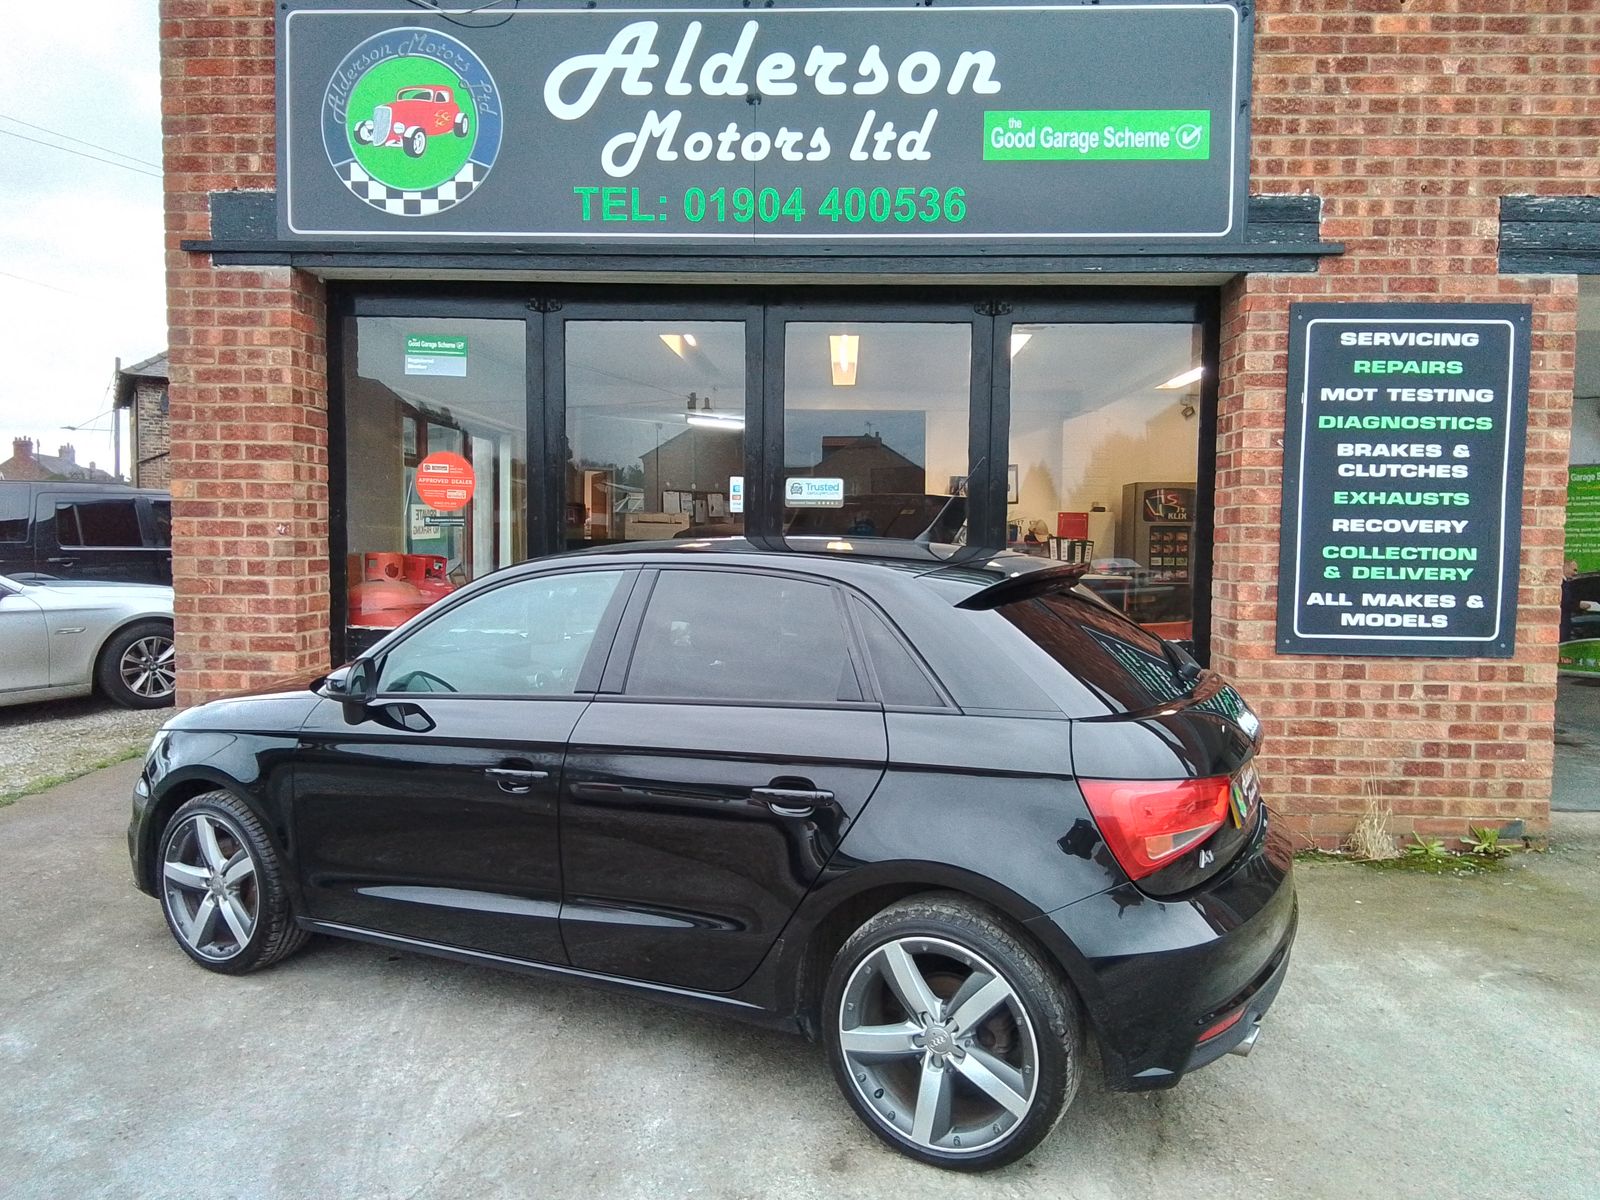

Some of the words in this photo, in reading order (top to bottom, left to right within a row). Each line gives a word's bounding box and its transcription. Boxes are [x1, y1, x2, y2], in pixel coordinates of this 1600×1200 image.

[543, 19, 1002, 120] Alderson
[327, 45, 393, 125] Alderson
[397, 33, 471, 72] Motors
[1008, 117, 1022, 129] the
[601, 109, 832, 178] Motors
[849, 108, 939, 162] ltd
[990, 127, 1036, 149] Good
[1040, 127, 1099, 153] Garage
[1103, 126, 1170, 148] Scheme
[573, 187, 667, 221] TEL:
[683, 187, 806, 222] 01904
[818, 187, 967, 222] 400536
[1340, 331, 1480, 347] SERVICING
[1354, 360, 1463, 375] REPAIRS
[1320, 387, 1378, 401] MOT
[1386, 388, 1494, 402] TESTING
[1318, 415, 1493, 431] DIAGNOSTICS
[1337, 443, 1442, 458] BRAKES
[1453, 444, 1470, 458] &
[1338, 464, 1468, 479] CLUTCHES
[1570, 473, 1595, 483] Garage
[806, 482, 839, 492] Trusted
[1334, 491, 1470, 506] EXHAUSTS
[1167, 512, 1187, 520] KLIX
[1332, 518, 1469, 533] RECOVERY
[1322, 545, 1477, 561] COLLECTION
[1323, 566, 1341, 579] &
[1352, 566, 1473, 581] DELIVERY
[1306, 592, 1352, 606] ALL
[1362, 593, 1456, 608] MAKES
[1466, 595, 1484, 609] &
[1340, 613, 1448, 628] MODELS
